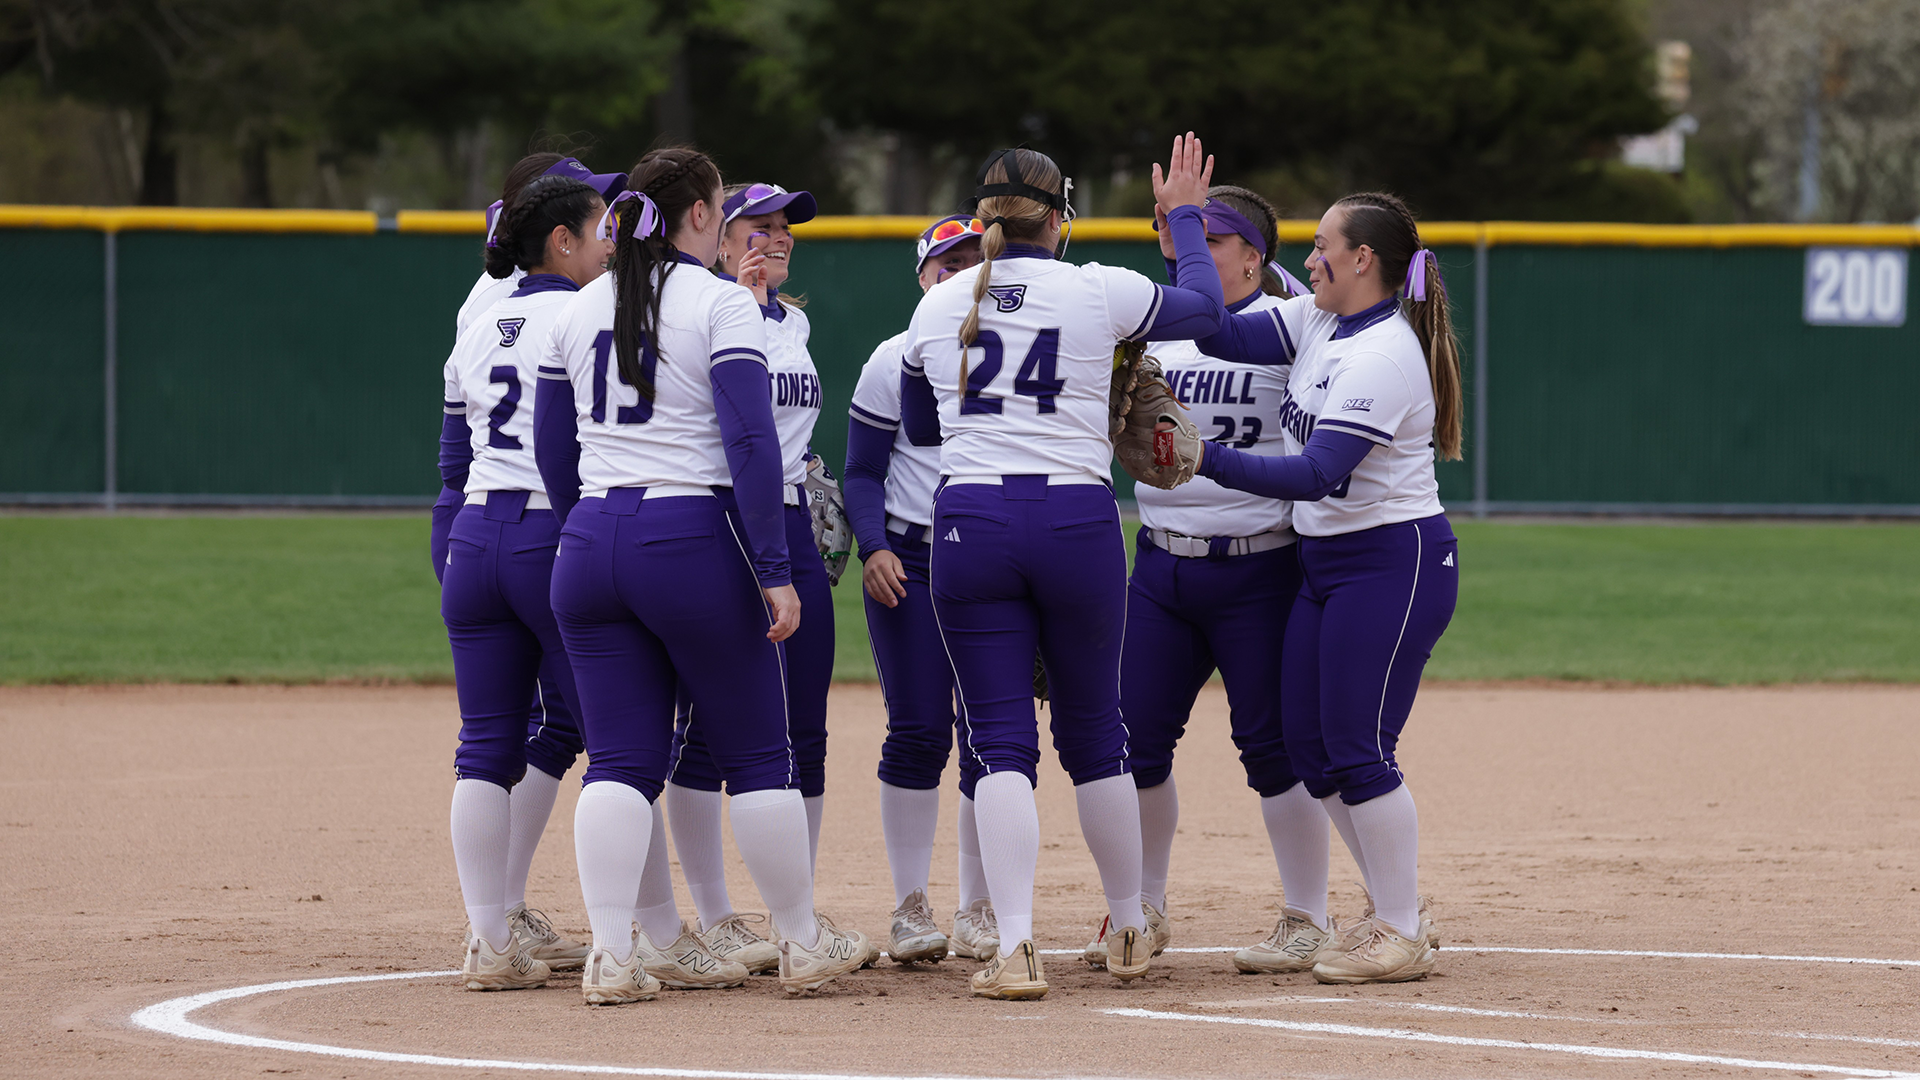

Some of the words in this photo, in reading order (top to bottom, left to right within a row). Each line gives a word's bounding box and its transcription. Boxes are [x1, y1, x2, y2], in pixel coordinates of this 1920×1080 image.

[1811, 250, 1903, 320] 200
[591, 329, 658, 425] 19
[959, 327, 1067, 416] 24
[1341, 398, 1374, 410] NEC
[485, 364, 523, 450] 2
[1209, 416, 1262, 449] 23
[815, 490, 823, 501] 22
